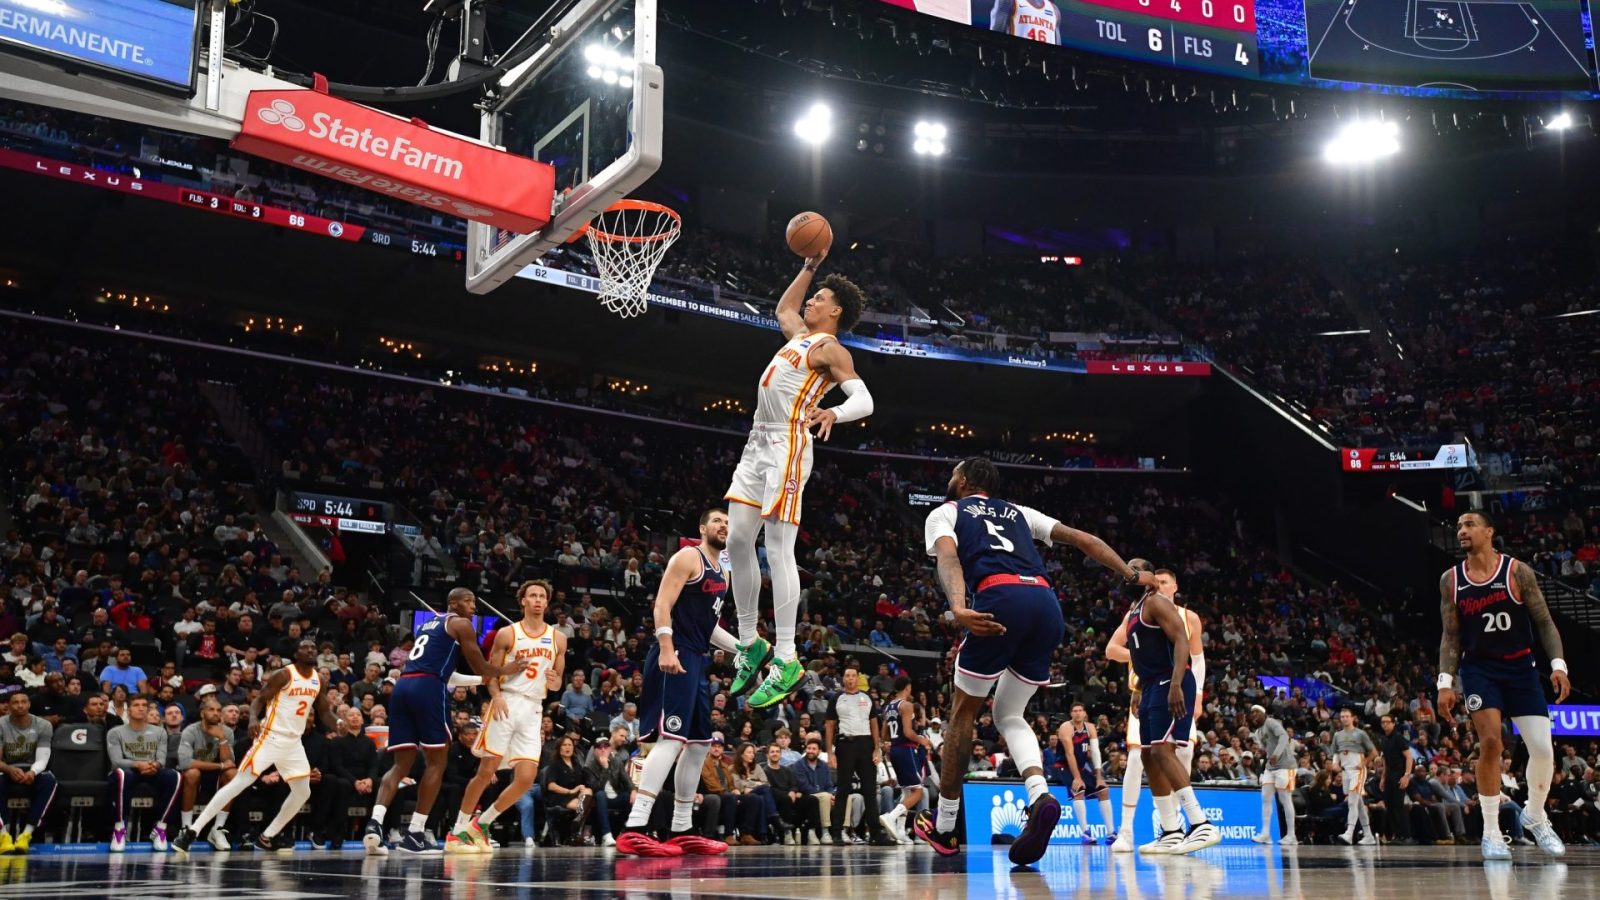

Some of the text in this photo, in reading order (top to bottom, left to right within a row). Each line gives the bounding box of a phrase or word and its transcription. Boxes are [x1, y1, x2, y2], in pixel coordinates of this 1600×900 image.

[1018, 14, 1055, 31] ATLANTA
[1233, 4, 1245, 23] 0
[1096, 19, 1249, 66] TOL 6 FLS 4
[36, 161, 143, 191] LEXUS
[210, 197, 218, 208] 3
[252, 206, 260, 218] 3
[288, 214, 305, 228] 66
[372, 232, 391, 246] 3RD
[411, 240, 437, 257] 5:44
[535, 268, 548, 279] 62
[646, 293, 781, 329] DECEMBER TO REMEMBER SALES EVEN
[1008, 355, 1047, 368] Ends January 5
[1111, 364, 1184, 373] LEXUS
[762, 364, 776, 388] 1
[1350, 459, 1362, 469] 66
[1389, 451, 1407, 462] 5:44
[325, 499, 353, 517] 5:44
[999, 506, 1018, 523] JR.
[983, 518, 1015, 553] 5
[1458, 590, 1508, 616] Clippers
[1481, 611, 1512, 633] 20
[409, 634, 429, 661] 8
[1132, 631, 1140, 649] 1
[515, 647, 552, 661] ATLANTA
[525, 661, 539, 679] 5
[288, 687, 317, 698] ATLANT
[296, 700, 308, 716] 2
[71, 729, 87, 744] G
[887, 720, 899, 739] 12
